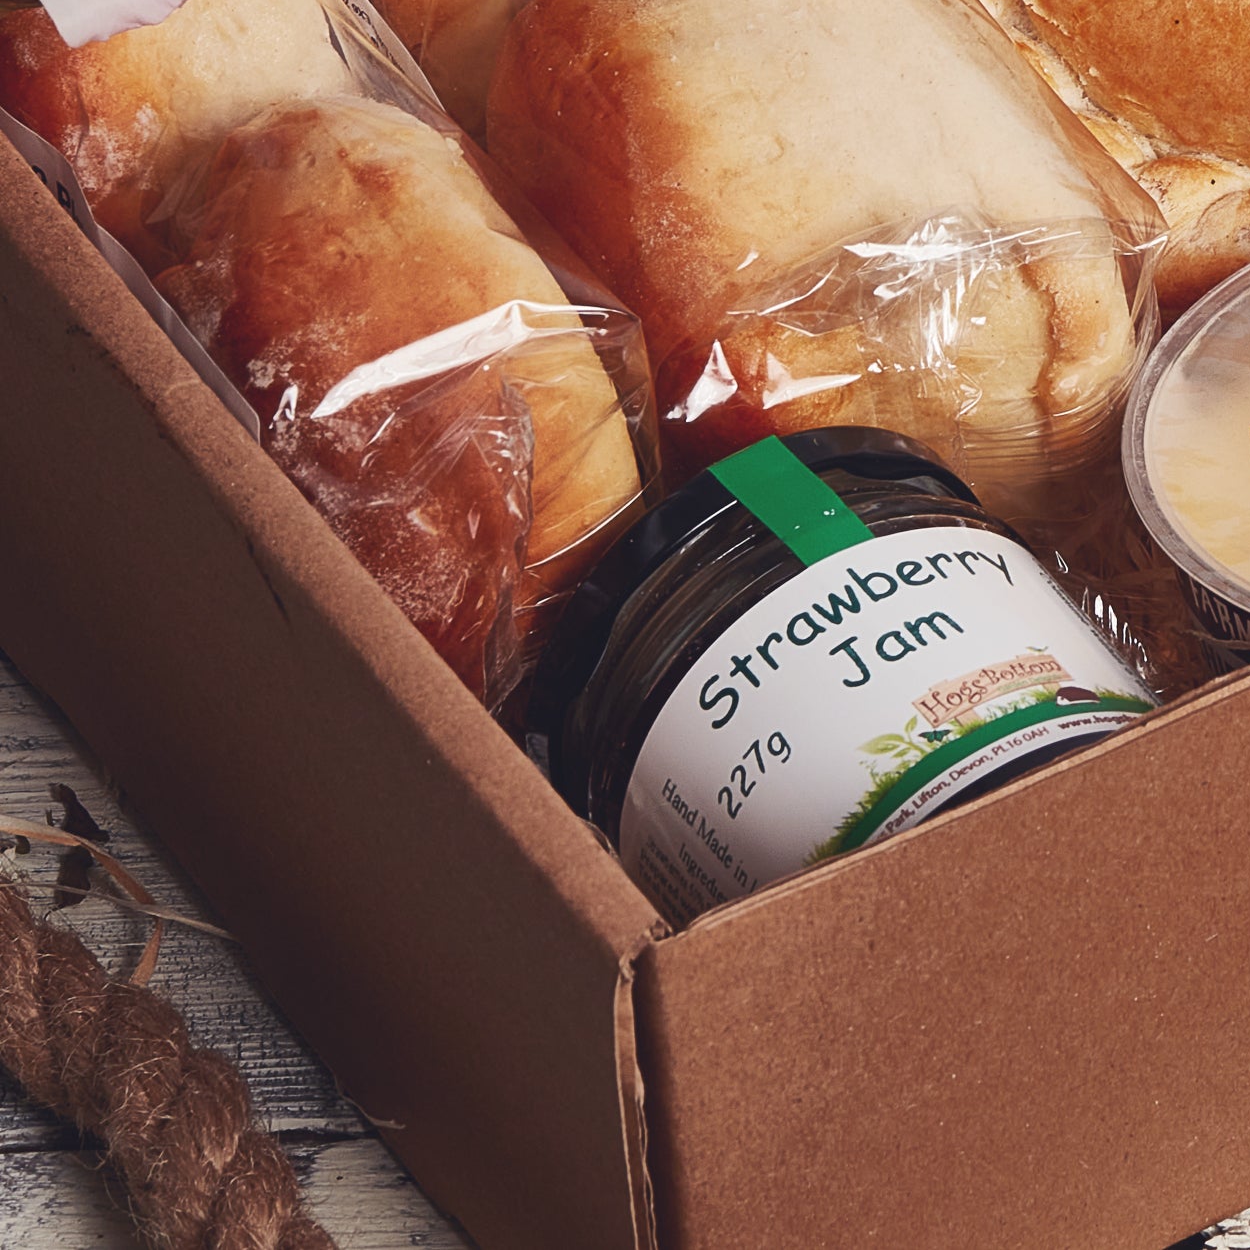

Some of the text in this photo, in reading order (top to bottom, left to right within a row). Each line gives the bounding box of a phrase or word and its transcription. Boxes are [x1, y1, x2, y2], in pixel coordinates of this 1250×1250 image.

[699, 550, 1014, 729] Strawberry
[829, 611, 964, 688] Jam
[717, 731, 792, 820] 227g
[885, 808, 915, 833] Park,
[912, 780, 951, 810] Lifton,
[948, 754, 993, 781] Devon,
[661, 778, 699, 826] Hand
[696, 817, 733, 869] Made
[733, 859, 748, 888] in
